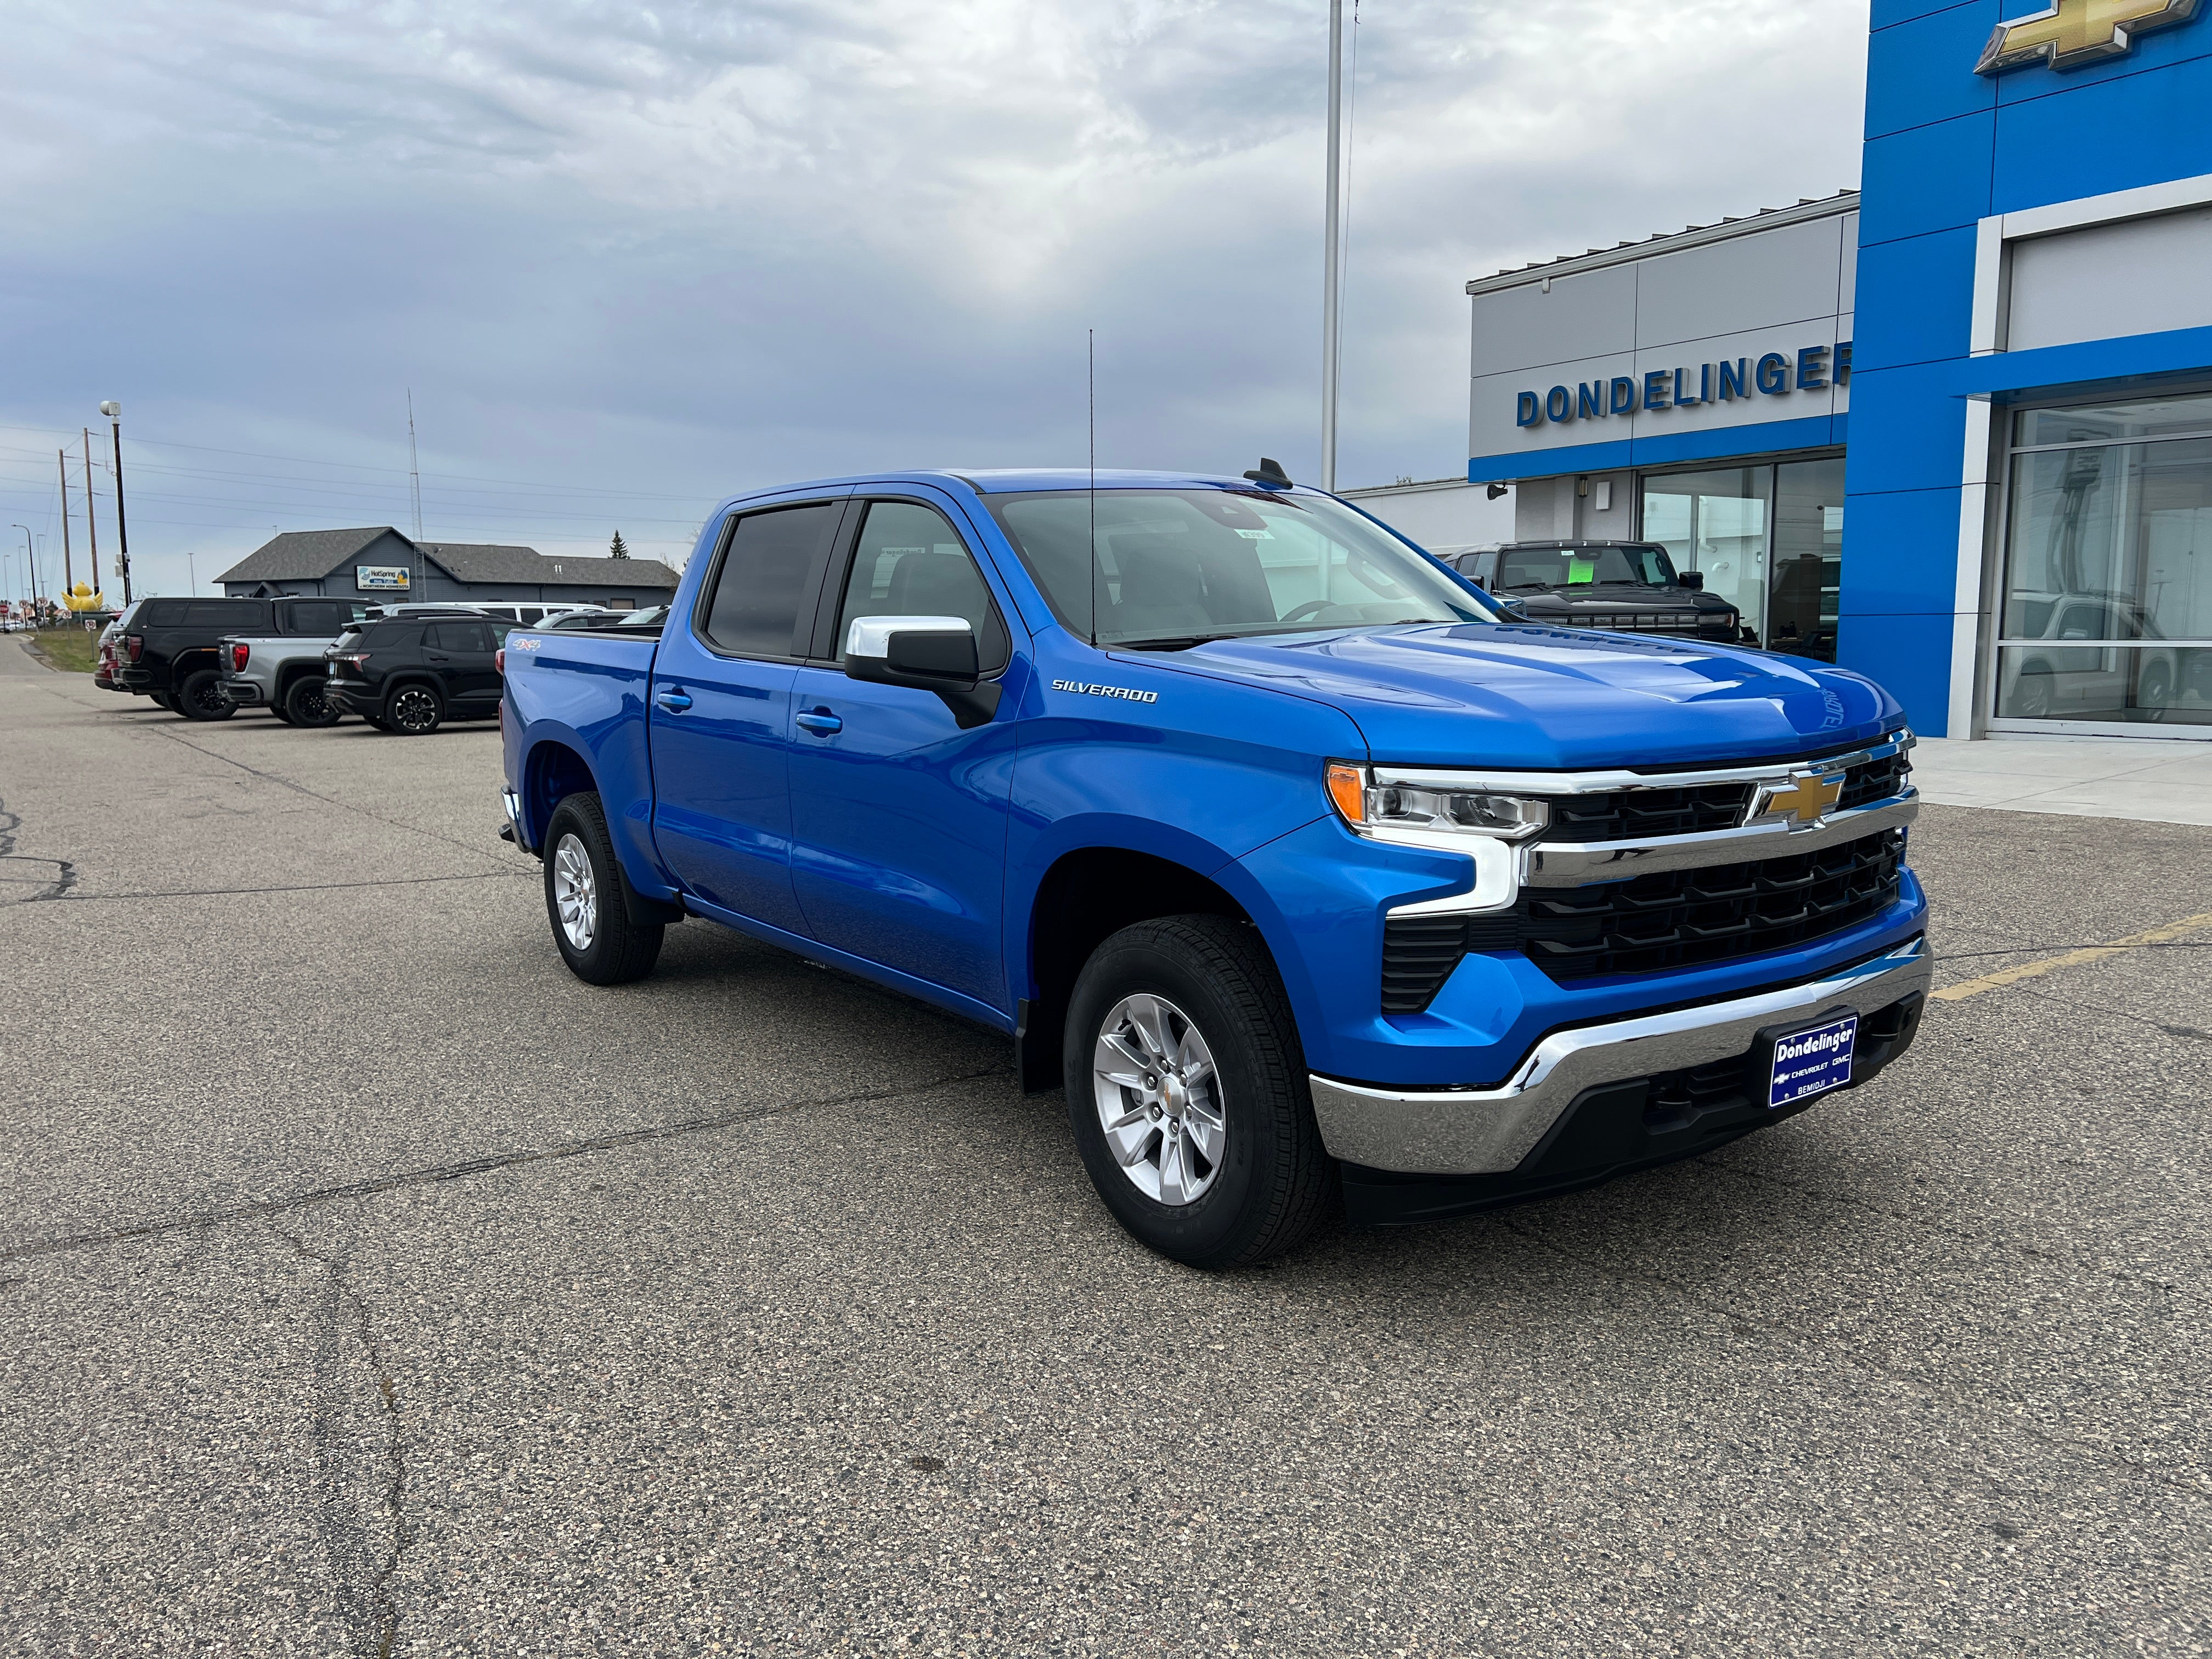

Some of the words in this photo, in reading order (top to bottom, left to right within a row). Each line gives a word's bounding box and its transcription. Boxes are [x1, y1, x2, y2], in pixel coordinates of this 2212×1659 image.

[1051, 679, 1159, 704] SILVERADO
[1776, 1028, 1853, 1063] Dondelinger
[1791, 1062, 1828, 1079] CHEVROLET
[1832, 1053, 1850, 1066] GMC
[1797, 1079, 1826, 1095] BEMIDJI
